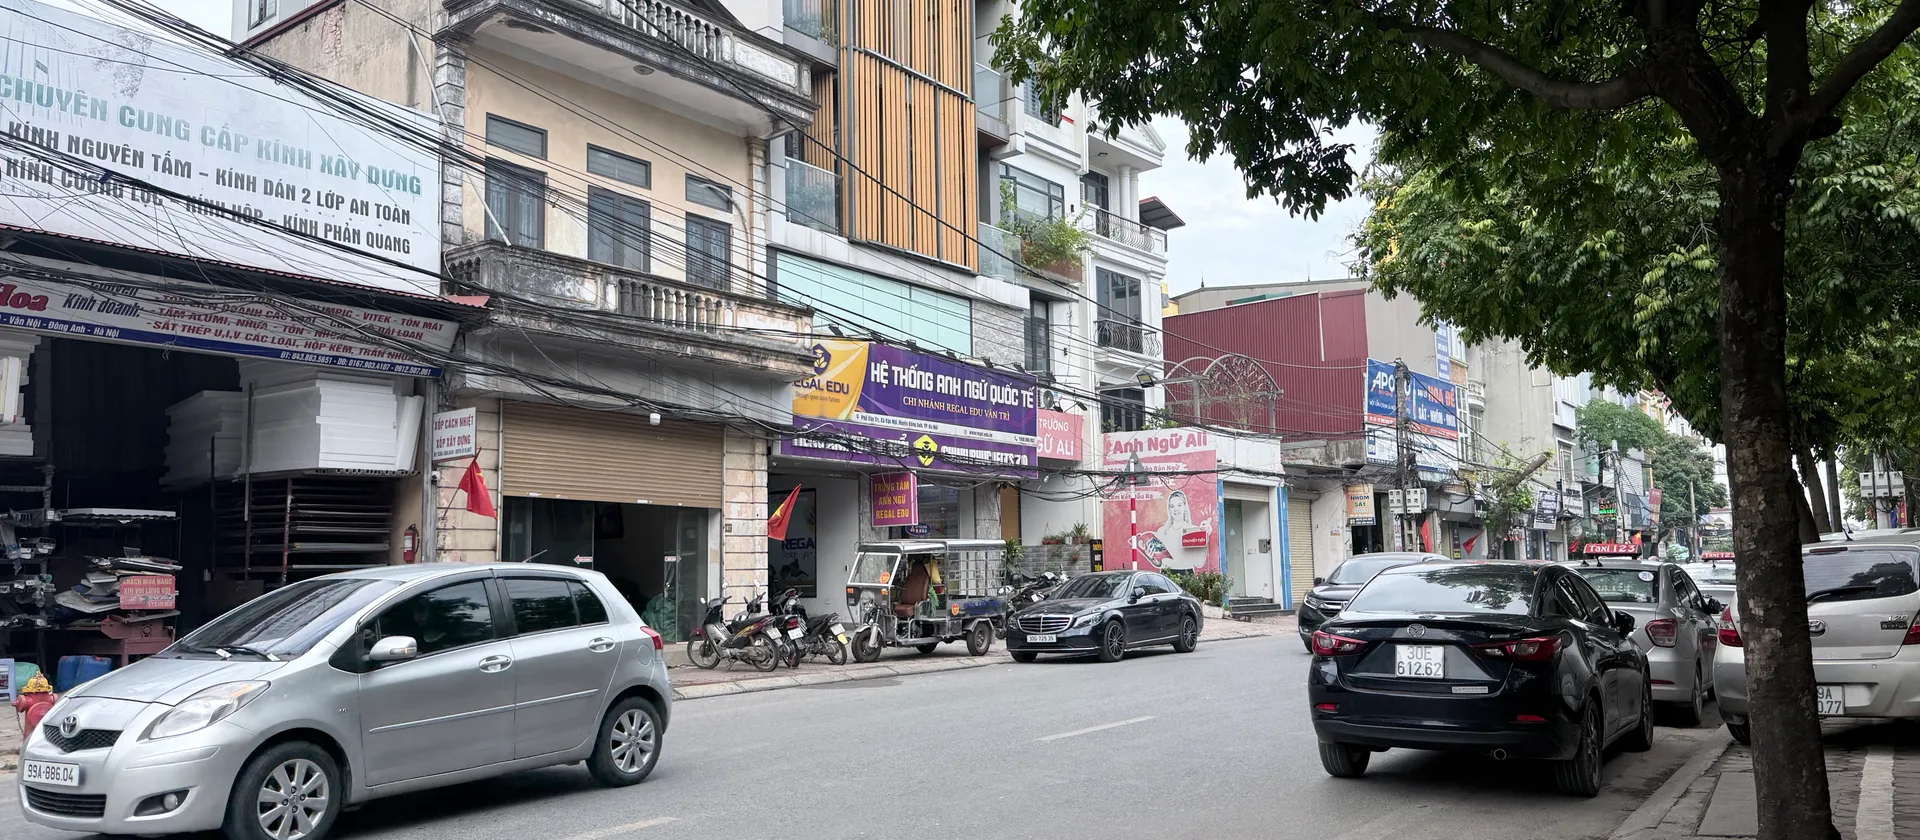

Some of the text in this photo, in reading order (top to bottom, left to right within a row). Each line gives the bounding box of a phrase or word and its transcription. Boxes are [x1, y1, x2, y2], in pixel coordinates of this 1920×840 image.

[0, 73, 422, 196] CHUYÊN CUNG CẤP KÍNH XÂY DỰNG
[8, 120, 410, 226] KÍNH NGUYÊN TẤM KÍNH DÁN 2 LỚP AN TOÀN
[6, 157, 54, 185] KÍNH
[283, 212, 318, 238] KÍNH
[324, 217, 361, 245] PHẢN
[366, 230, 411, 255] QUANG
[62, 292, 97, 312] Kinh
[362, 312, 392, 324] VITEK
[26, 318, 42, 328] Nội
[48, 321, 69, 333] Đông
[70, 325, 86, 334] Anh
[93, 328, 105, 336] Hà
[105, 329, 120, 338] Nội
[153, 319, 178, 332] SẮT
[180, 323, 212, 336] THÉP
[244, 331, 268, 344] CÁC
[303, 338, 326, 352] HỘP
[282, 323, 305, 335] TÔN
[792, 378, 850, 395] EGAL EDU
[870, 360, 1035, 409] HỆ THỐNG ANH NGỮ QUỐC TẾ
[1370, 370, 1412, 396] APOO
[1427, 385, 1445, 405] HOA
[902, 396, 917, 407] CHI
[918, 396, 945, 411] NHÁNH
[946, 404, 969, 415] REGAL
[969, 407, 984, 417] EDU
[1418, 403, 1427, 420] SẮT
[1038, 417, 1069, 432] TRƯỜNG
[1037, 432, 1074, 456] GỮ ALI
[1113, 431, 1208, 454] Anh Ngữ Ali
[874, 483, 895, 493] TRUNG
[878, 495, 892, 506] ANH
[875, 508, 910, 519] REGAL EDU
[1590, 544, 1636, 552] Taxi 123
[123, 587, 131, 595] XIN
[1406, 645, 1433, 661] 30E
[1396, 661, 1442, 677] 612.62
[1817, 686, 1833, 700] 9A
[27, 763, 74, 783] 99A-886.04
